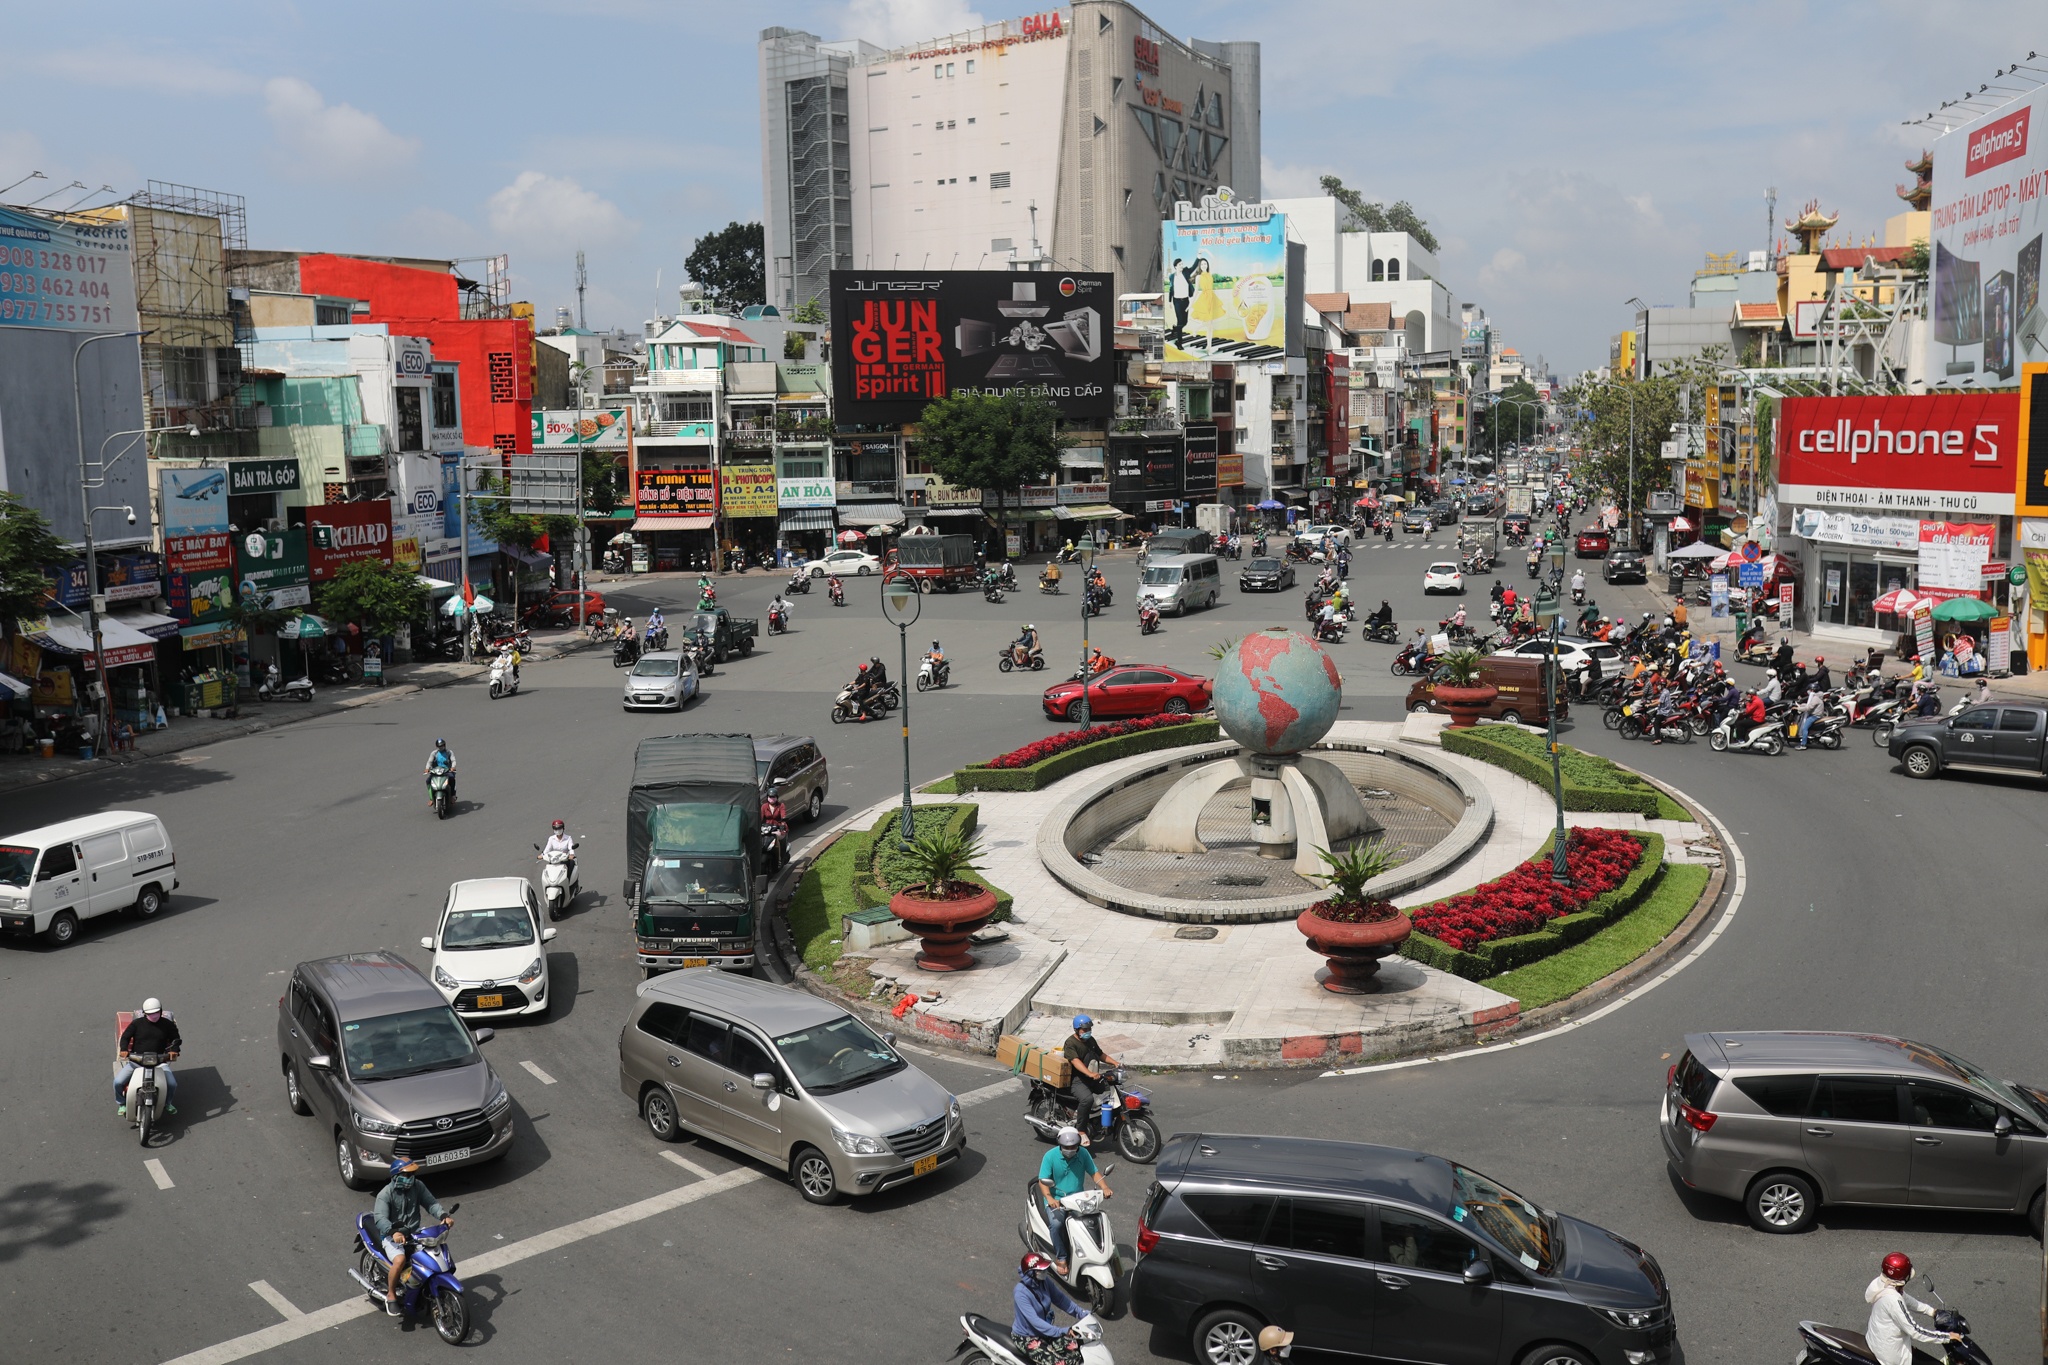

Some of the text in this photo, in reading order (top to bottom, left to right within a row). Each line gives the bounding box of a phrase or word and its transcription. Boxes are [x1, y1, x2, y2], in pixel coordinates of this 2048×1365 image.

[1023, 12, 1060, 35] GALA
[909, 47, 950, 60] WEDDING
[960, 37, 1020, 53] CONVENTION
[1023, 28, 1063, 44] CENTER
[1135, 35, 1158, 66] GALA
[1933, 202, 1958, 232] TRUNG
[1958, 193, 1976, 226] TÂM
[1976, 182, 2010, 218] LAPTOP
[2019, 167, 2043, 205] MÁY
[1177, 199, 1272, 223] Enchanteur
[75, 227, 128, 239] PACIFIC
[76, 240, 128, 251] OUTDOOR
[39, 250, 72, 271] 328
[77, 255, 106, 274] 017
[42, 277, 74, 296] 462
[79, 281, 110, 299] 404
[1077, 279, 1102, 287] German
[1077, 286, 1092, 294] Spirit
[43, 303, 76, 322] 755
[81, 305, 111, 324] 751
[852, 300, 936, 332] JUN
[851, 331, 944, 363] GER
[405, 355, 421, 369] ECO
[902, 363, 941, 371] GERMAN
[857, 374, 919, 399] spirit
[1075, 382, 1102, 397] CẤP
[547, 424, 572, 433] 50%
[865, 443, 889, 451] SAIGON
[234, 465, 295, 487] BÁN TRẢ GÓP
[656, 475, 686, 484] MINH
[723, 474, 775, 484] IN PHOTOCOPY
[754, 485, 775, 493] A4
[781, 483, 832, 497] AN HÒA
[418, 494, 434, 509] ECO
[1816, 489, 1977, 509] ĐIỆN THOẠI ÂM THANH THU CŨ
[1818, 532, 1843, 540] MODERN
[1851, 523, 1884, 535] 12.9 Triệu
[170, 536, 227, 552] VÉ MÁY BAY
[1932, 533, 1948, 544] GIÁ
[1950, 534, 1970, 545] SIÊU
[182, 552, 201, 560] CHÍNH
[325, 552, 348, 560] Perfumes
[71, 571, 88, 587] 341
